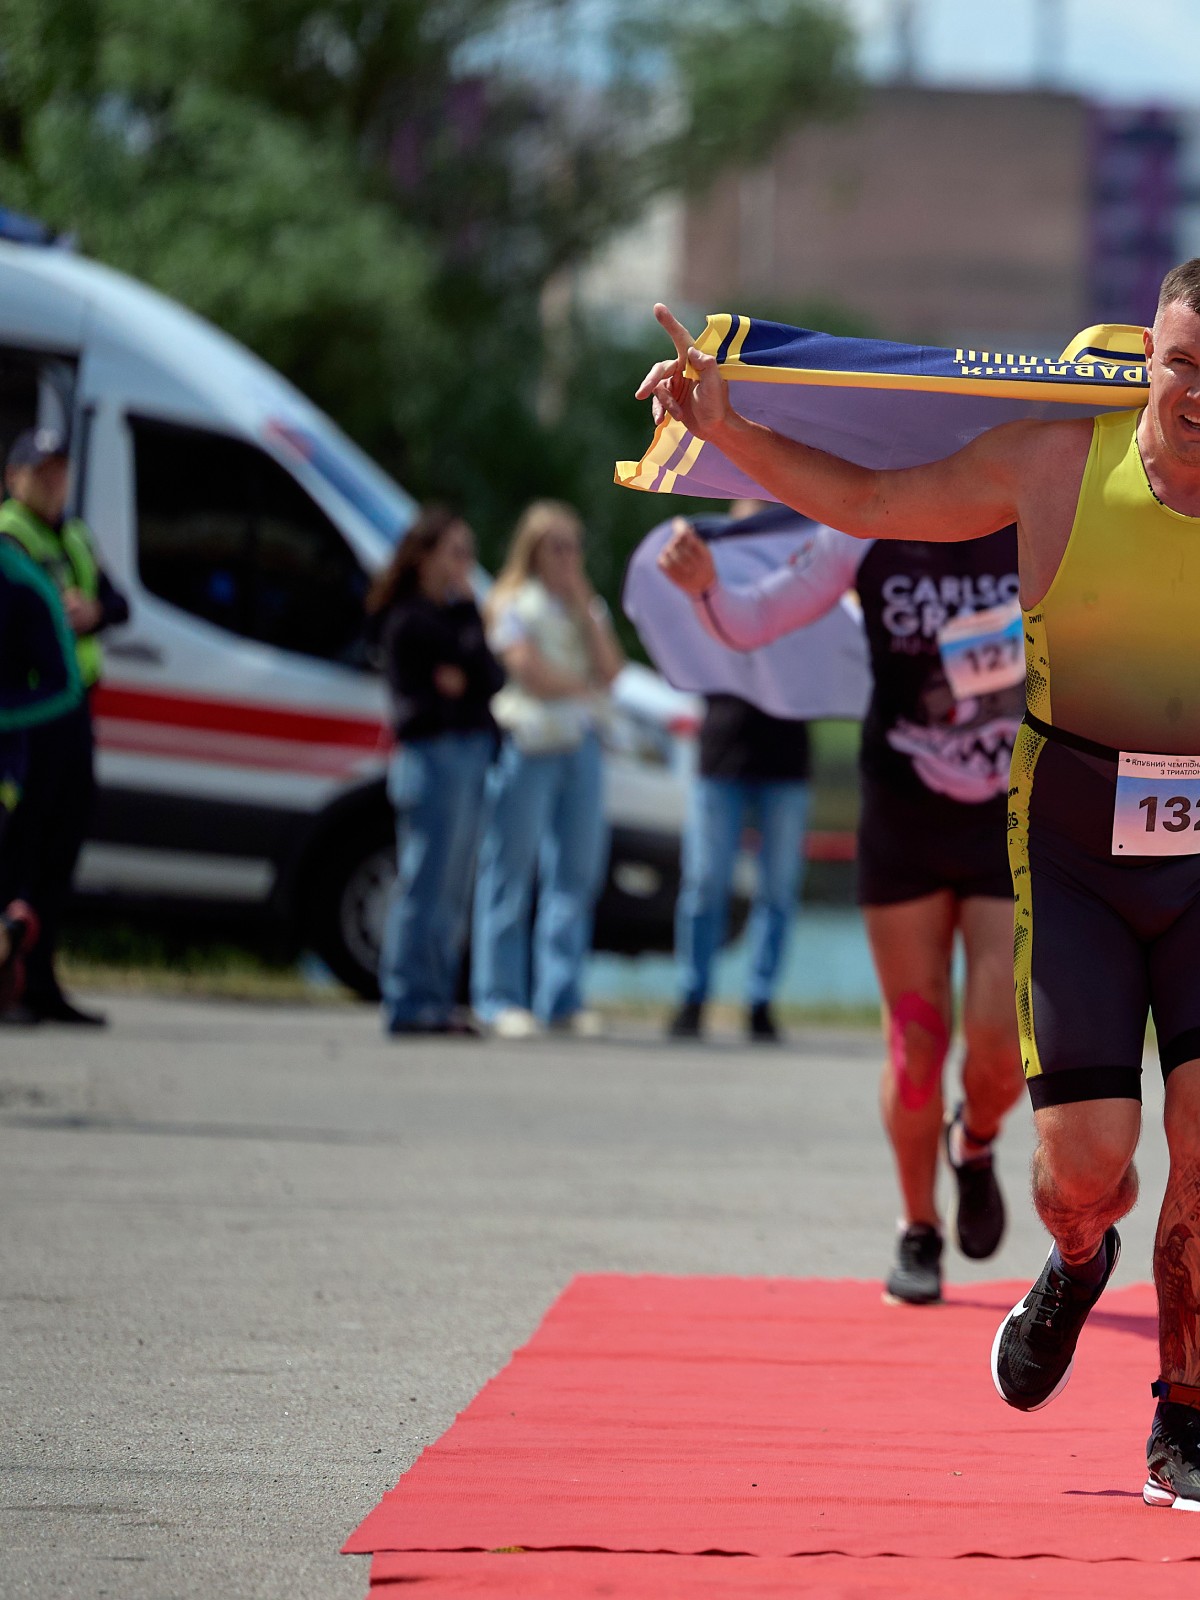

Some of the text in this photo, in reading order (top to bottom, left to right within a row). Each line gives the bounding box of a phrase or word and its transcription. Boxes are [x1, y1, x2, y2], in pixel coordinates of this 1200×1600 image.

[961, 365, 1151, 383] РАВЛІННЯ
[882, 574, 1020, 606] CARLSO
[1131, 759, 1166, 768] КЛУБНИЙ
